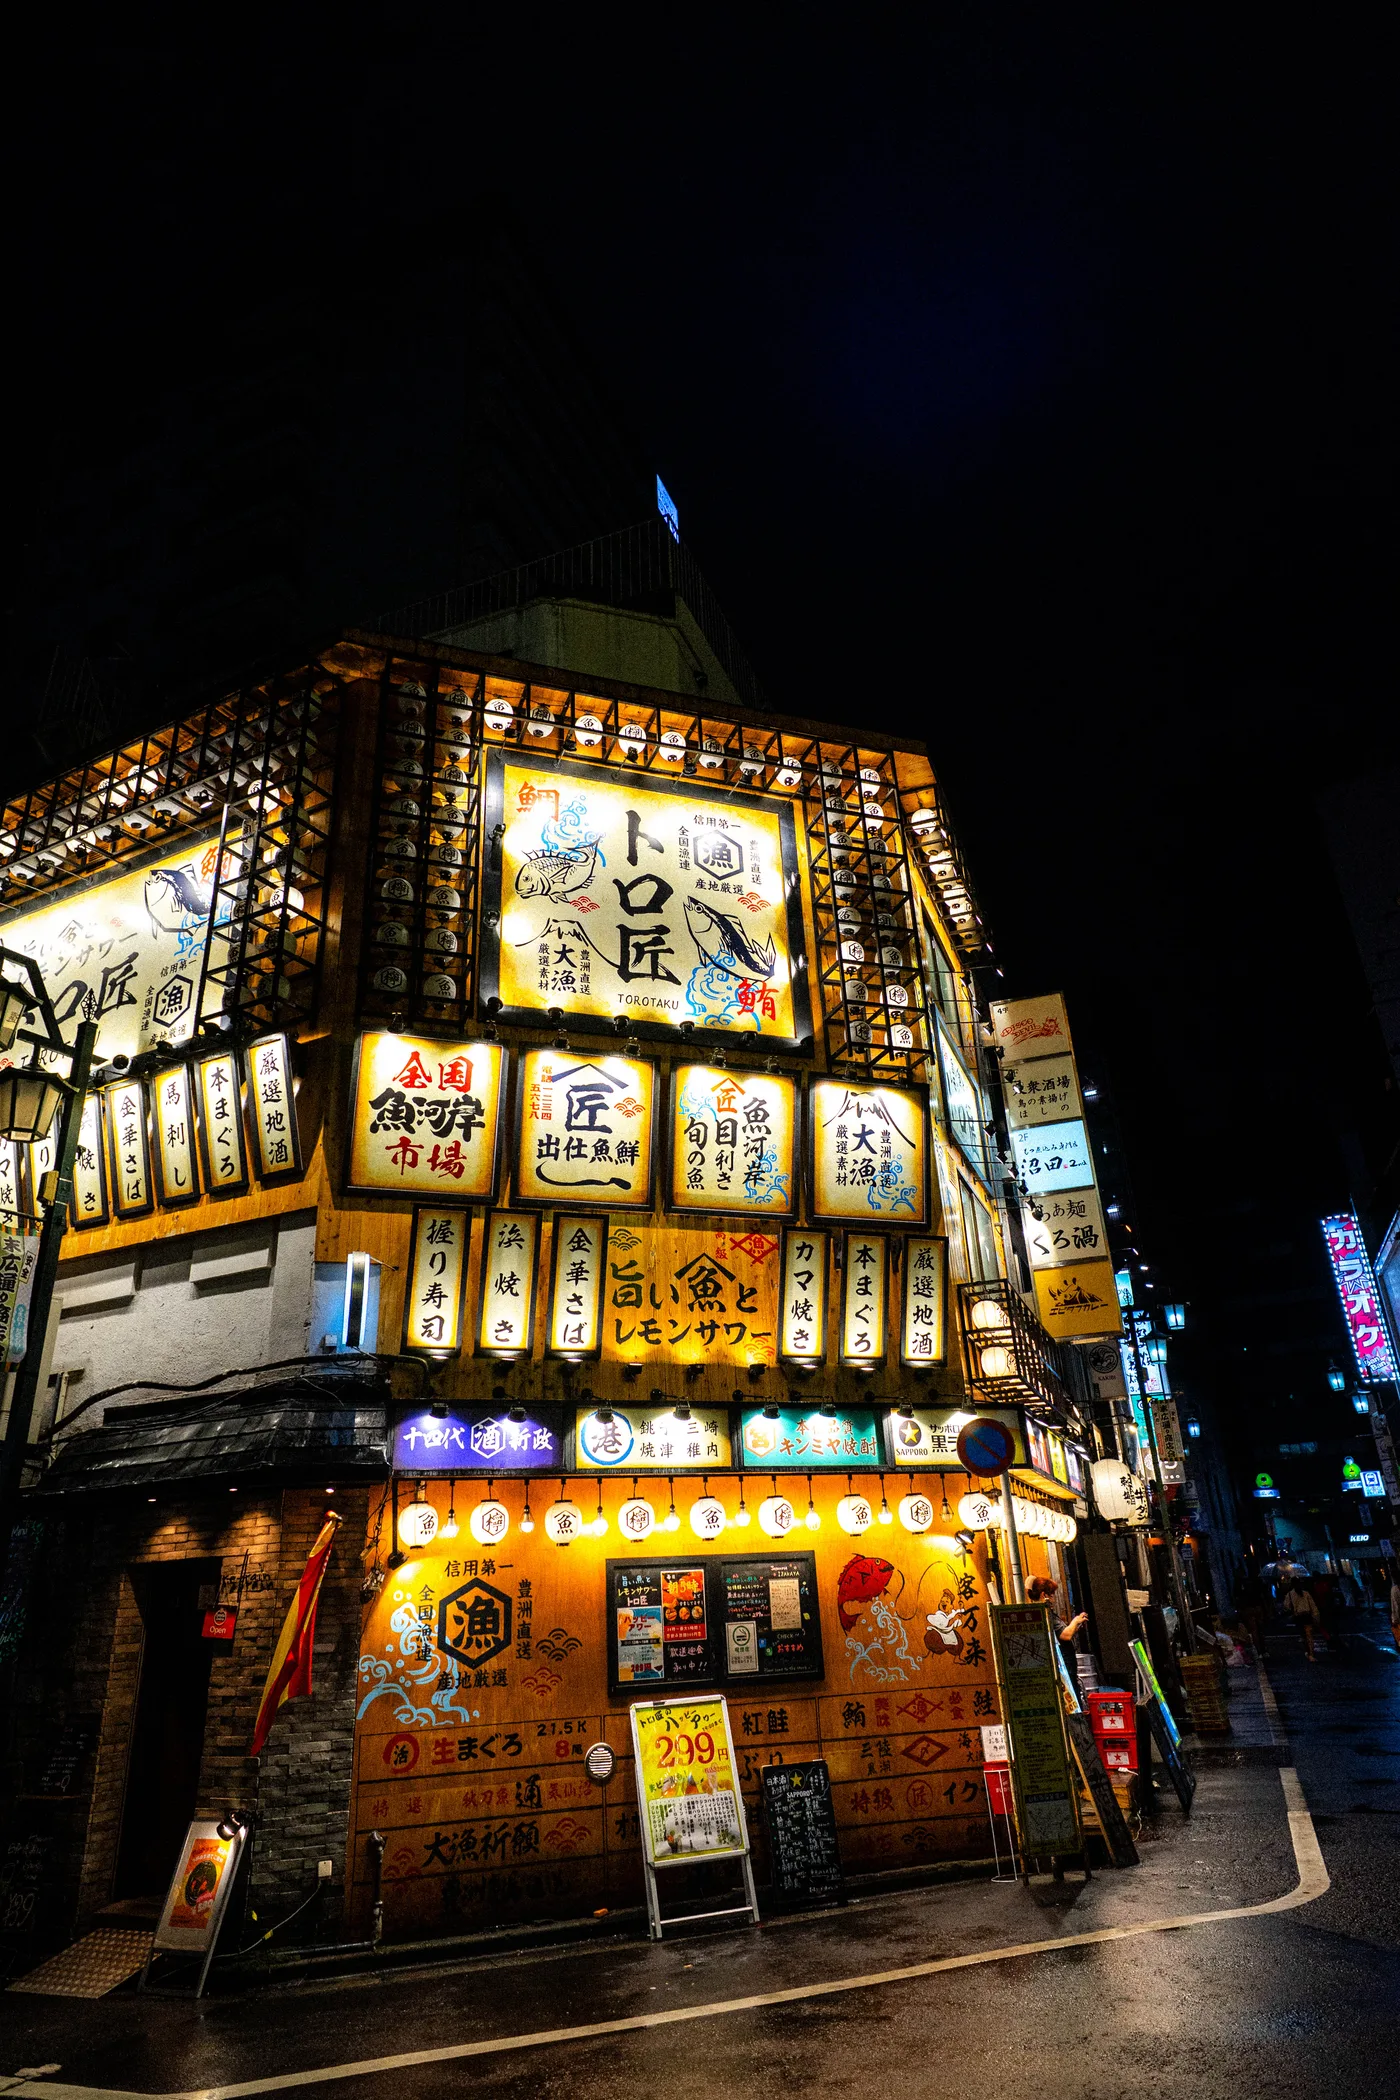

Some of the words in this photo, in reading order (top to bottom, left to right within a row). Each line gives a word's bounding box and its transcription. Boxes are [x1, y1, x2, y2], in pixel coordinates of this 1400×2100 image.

[693, 814, 741, 829] 信用第一
[678, 826, 691, 871] 全国漁連
[703, 841, 732, 868] 漁
[612, 810, 681, 986] トロ匠
[695, 881, 744, 895] 産地厳選
[160, 957, 196, 979] 信用第一
[538, 943, 550, 990] 厳選素材
[551, 944, 577, 994] 大漁
[580, 950, 591, 995] 豊洲直送
[140, 985, 154, 1032] 全国漁連
[161, 987, 184, 1017] 漁
[617, 993, 679, 1011] TOROTAKU
[737, 978, 779, 1021] 鮪
[148, 1022, 188, 1046] 産地厳選
[1001, 1018, 1033, 1038] DISCO
[392, 1051, 474, 1093] 全国
[260, 1051, 289, 1165] 厳選地酒
[368, 1088, 487, 1143] 魚河岸
[529, 1083, 541, 1120] 五六七八
[565, 1084, 614, 1134] 匠
[714, 1088, 737, 1114] 匠
[165, 1082, 187, 1189] 馬刺し
[210, 1067, 236, 1177] 本まぐろ
[119, 1094, 143, 1200] 金華さば
[742, 1097, 771, 1186] 魚河岸
[1018, 1133, 1028, 1142] 2F
[385, 1137, 467, 1179] 市場
[684, 1117, 708, 1191] 旬の魚
[714, 1117, 735, 1191] 目利き
[835, 1124, 849, 1187] 厳選素材
[850, 1124, 876, 1187] 大漁
[879, 1129, 892, 1189] 豊洲直送
[1022, 1156, 1062, 1177] 沼田
[749, 1236, 765, 1254] 漁
[1033, 1225, 1098, 1255] くろ渦
[421, 1220, 455, 1342] 握り寿司
[493, 1223, 523, 1343] 浜焼き
[564, 1227, 592, 1345] 金華さば
[612, 1261, 758, 1313] 旨い魚と
[791, 1241, 815, 1351] カマ焼き
[1330, 1228, 1380, 1347] カラオケ
[853, 1244, 876, 1353] 本まぐろ
[912, 1248, 935, 1355] 厳選地酒
[614, 1319, 772, 1347] レモンサワー
[403, 1427, 463, 1450] 十四代
[474, 1424, 500, 1451] 酒
[509, 1428, 553, 1450] 新政
[592, 1424, 622, 1454] 港
[929, 1423, 966, 1434] サッポロ
[687, 1442, 719, 1458] 稚内
[779, 1436, 878, 1457] キンミヤ焼酎
[896, 1448, 929, 1456] SAPPORO
[1350, 1534, 1370, 1542] KEIO
[444, 1559, 514, 1578] 信用第一
[617, 1586, 658, 1597] レモンサワー
[627, 1596, 648, 1606] トロ匠
[209, 1625, 227, 1634] Open
[415, 1585, 435, 1662] 全国漁連
[453, 1595, 501, 1650] 漁
[515, 1579, 533, 1660] 豊洲直送
[624, 1615, 655, 1623] ハッピー
[777, 1644, 804, 1653] おすすめ
[436, 1668, 509, 1691] 産地厳選
[842, 1701, 866, 1729] 鮪
[874, 1698, 890, 1728] 美味
[972, 1690, 997, 1717] 鮭
[742, 1708, 789, 1736] 紅鮭
[431, 1732, 523, 1766] 生まぐろ
[655, 1732, 715, 1768] 299
[718, 1748, 729, 1761] 円
[860, 1738, 893, 1759] 三陸
[766, 1775, 787, 1786] 日本酒
[851, 1787, 896, 1815] 特級
[912, 1787, 928, 1806] 匠
